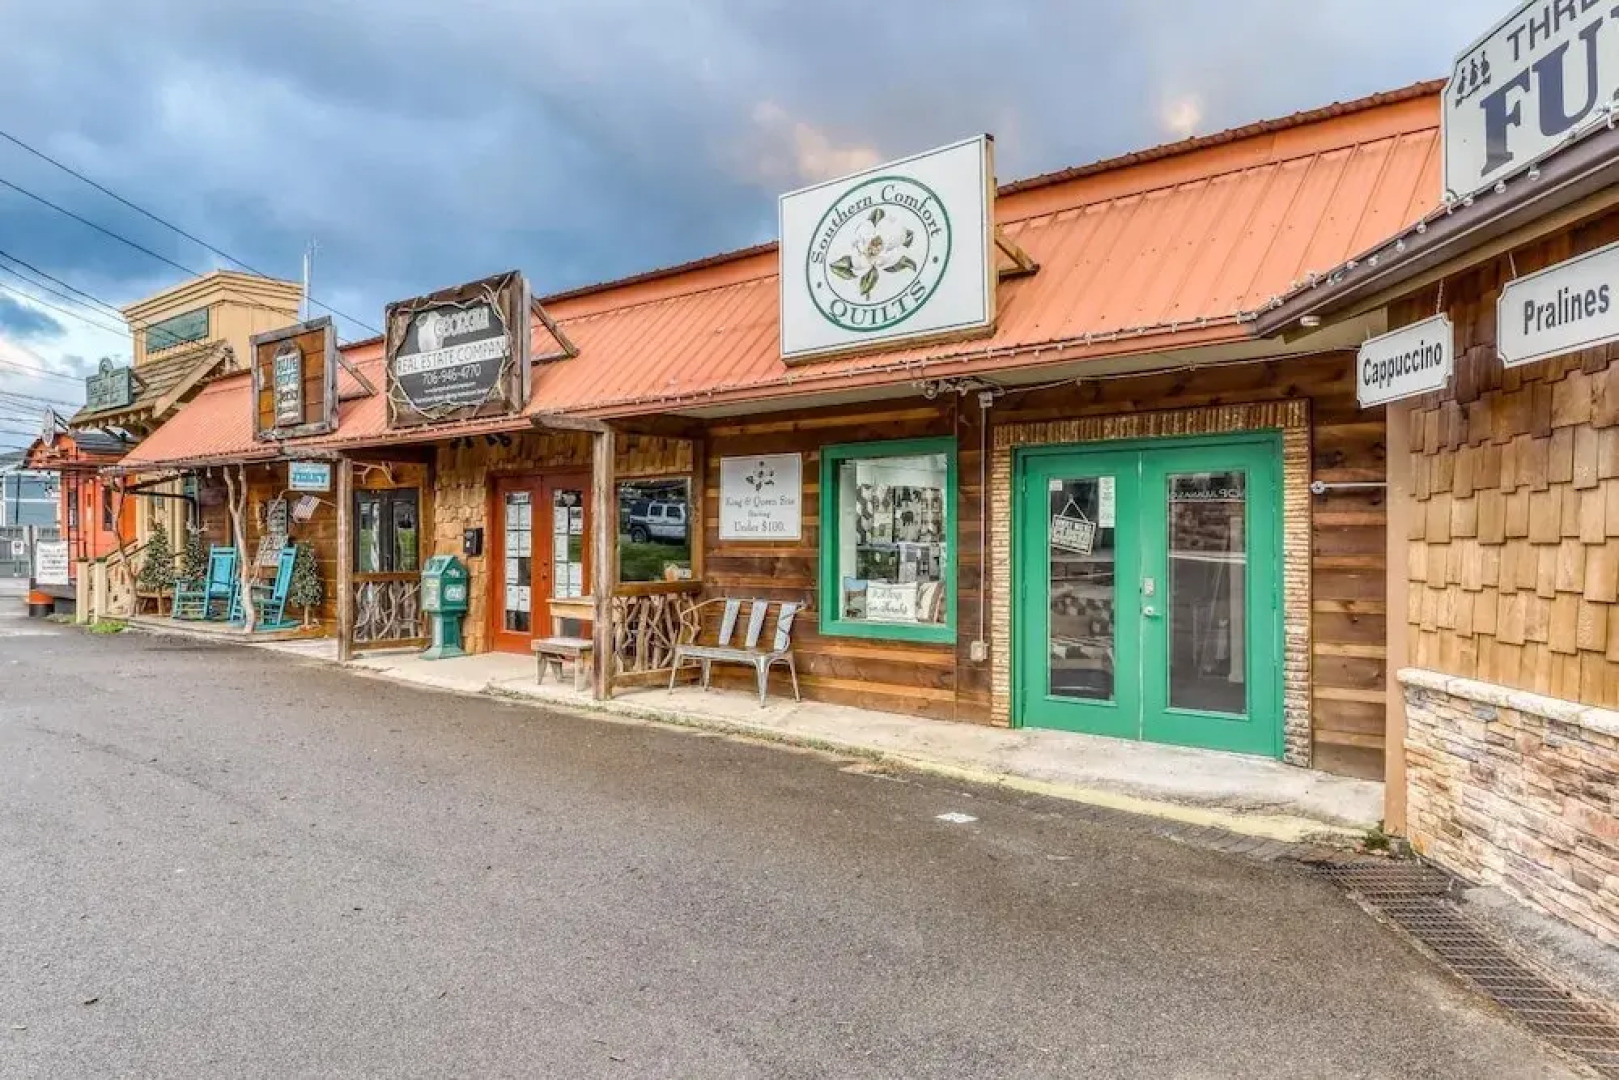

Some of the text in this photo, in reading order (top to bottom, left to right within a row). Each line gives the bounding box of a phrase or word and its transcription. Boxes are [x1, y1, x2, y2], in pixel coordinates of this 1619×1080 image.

[1480, 5, 1619, 177] FU
[811, 184, 942, 265] Southern Comfort
[829, 279, 928, 325] QUILTS
[1523, 284, 1610, 335] Pralines
[421, 348, 454, 370] ESTATE
[1362, 340, 1443, 390] Cappuccino
[734, 520, 759, 532] Under
[754, 496, 778, 508] Queen
